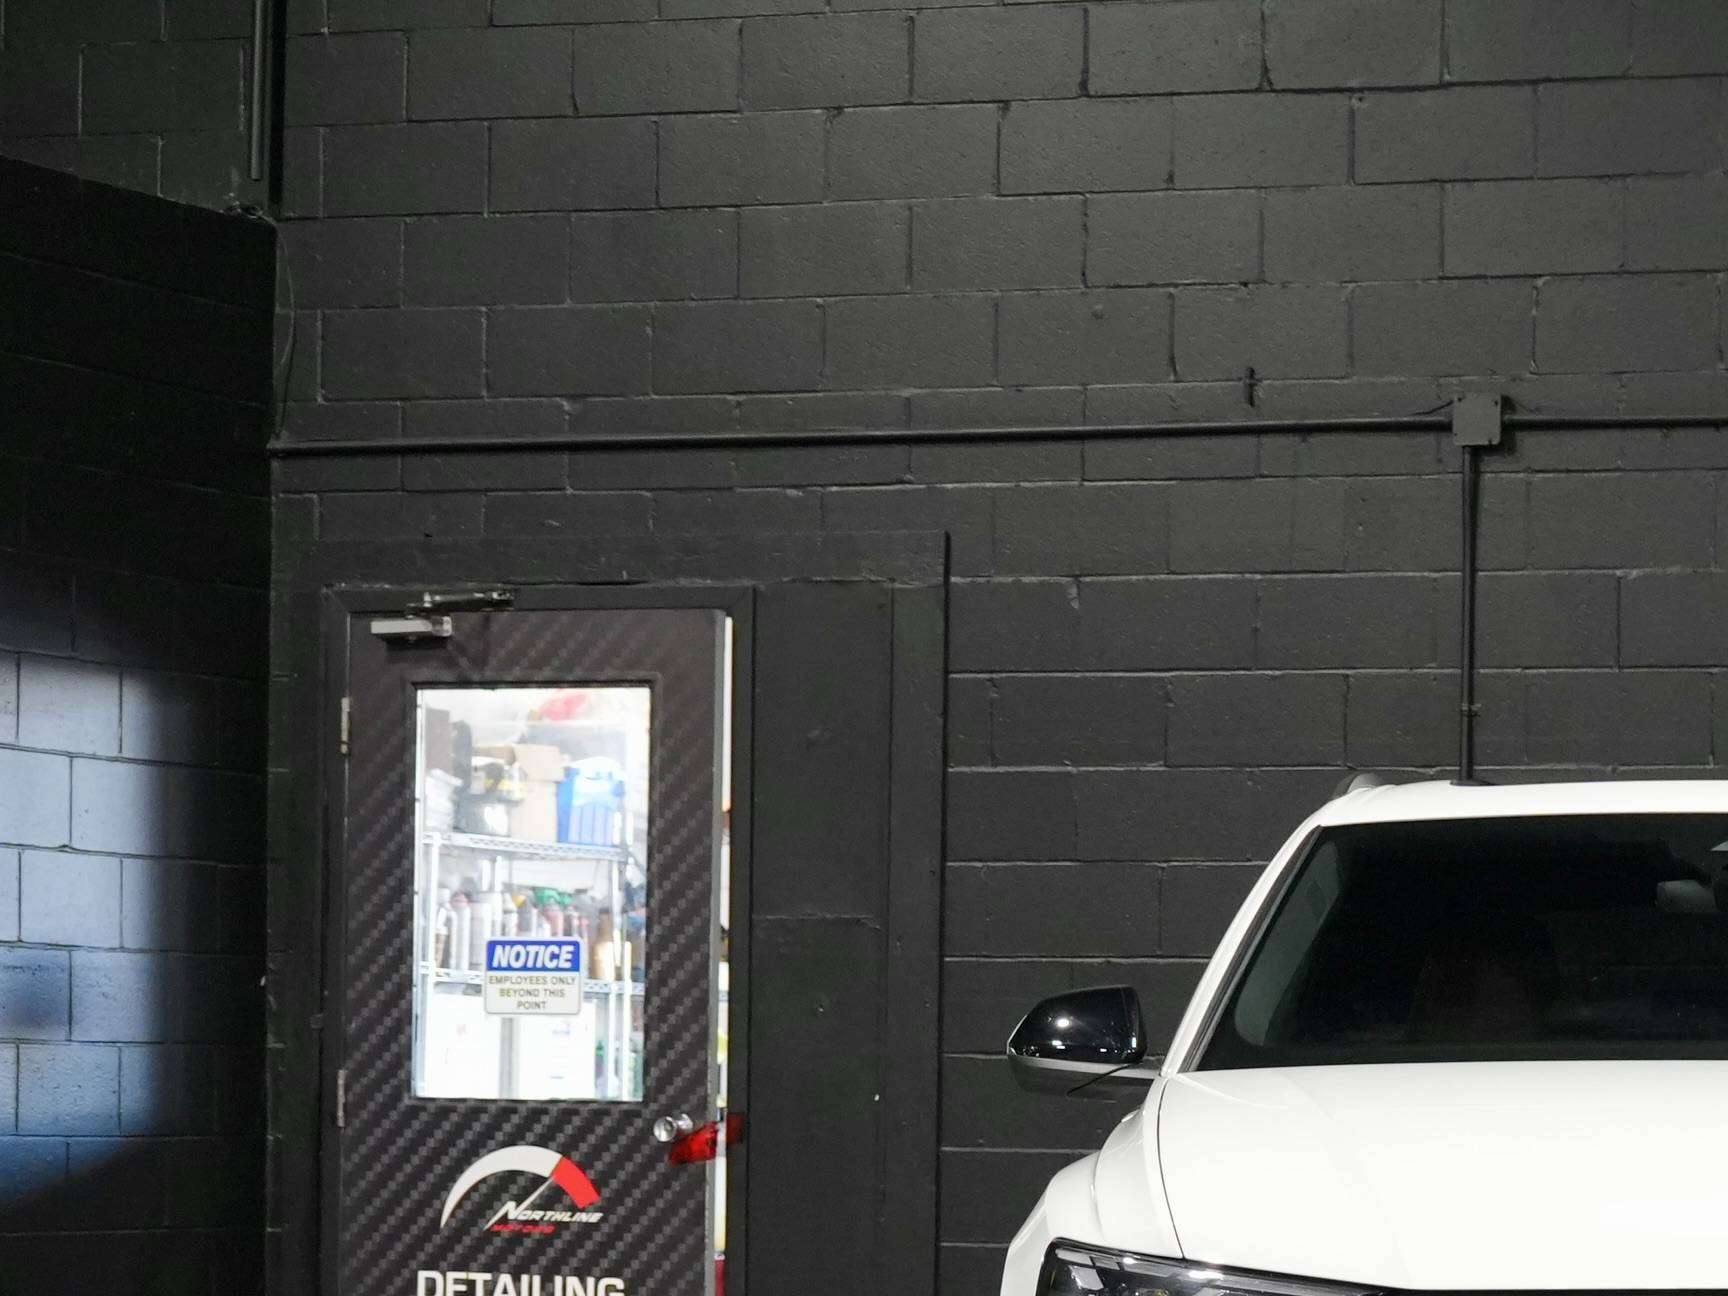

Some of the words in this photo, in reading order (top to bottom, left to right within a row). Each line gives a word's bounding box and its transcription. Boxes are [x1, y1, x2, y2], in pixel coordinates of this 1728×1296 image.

[492, 944, 575, 969] NOTICE
[488, 975, 548, 985] EMPLOYEES
[550, 975, 576, 985] ONLY
[499, 988, 540, 997] BEYOND
[543, 988, 565, 998] THIS
[517, 1000, 547, 1010] POINT
